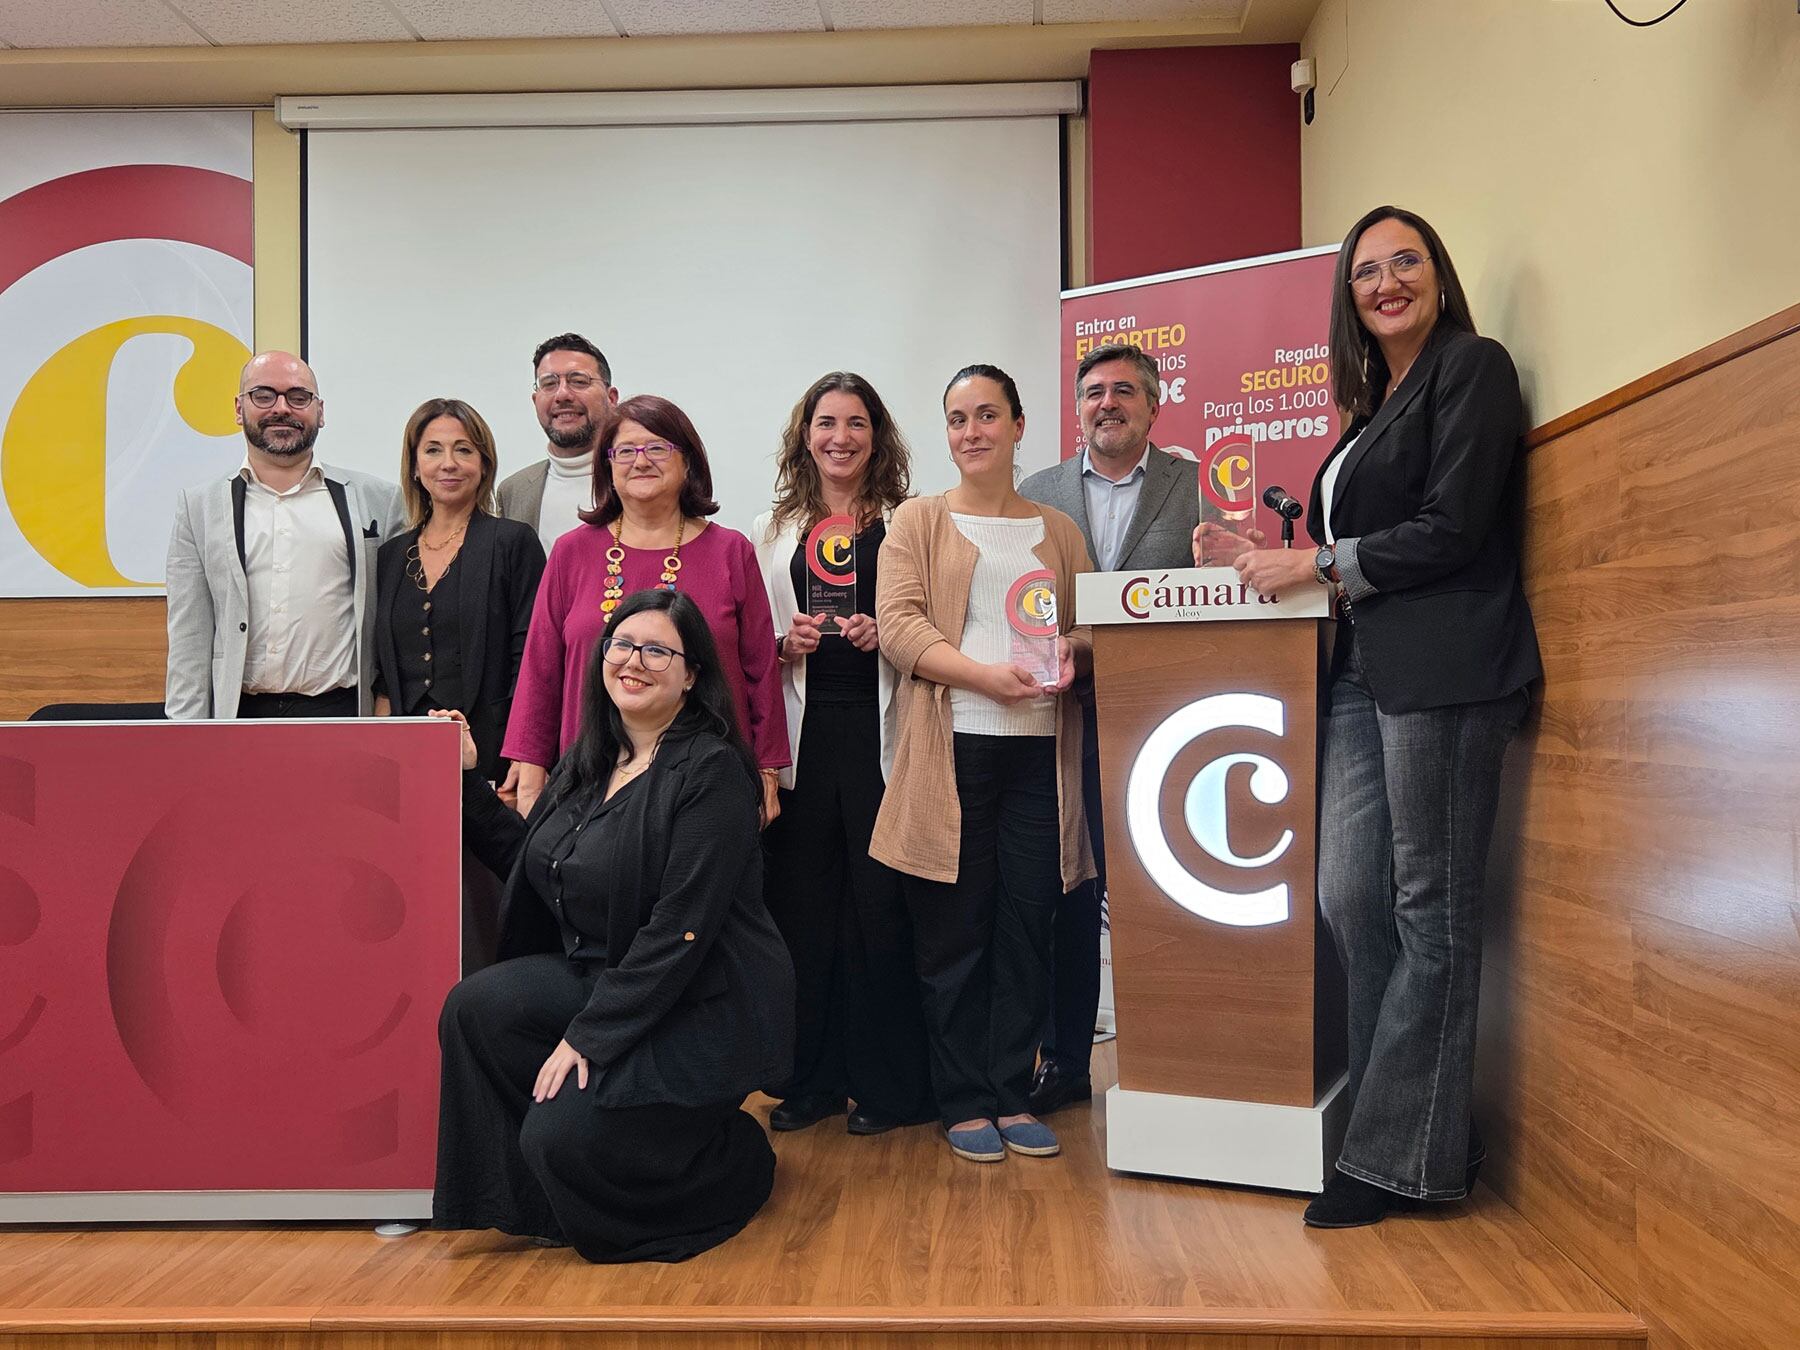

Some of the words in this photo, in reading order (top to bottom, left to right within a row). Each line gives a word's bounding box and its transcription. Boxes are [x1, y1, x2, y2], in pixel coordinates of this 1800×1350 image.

[1075, 318, 1115, 337] Entra
[1118, 315, 1136, 330] en
[1274, 343, 1330, 366] Regalo
[1240, 362, 1329, 393] SEGURO
[1203, 401, 1243, 419] Para
[1248, 396, 1274, 414] los
[1278, 388, 1329, 411] 1.000
[1175, 609, 1202, 619] Alcoy
